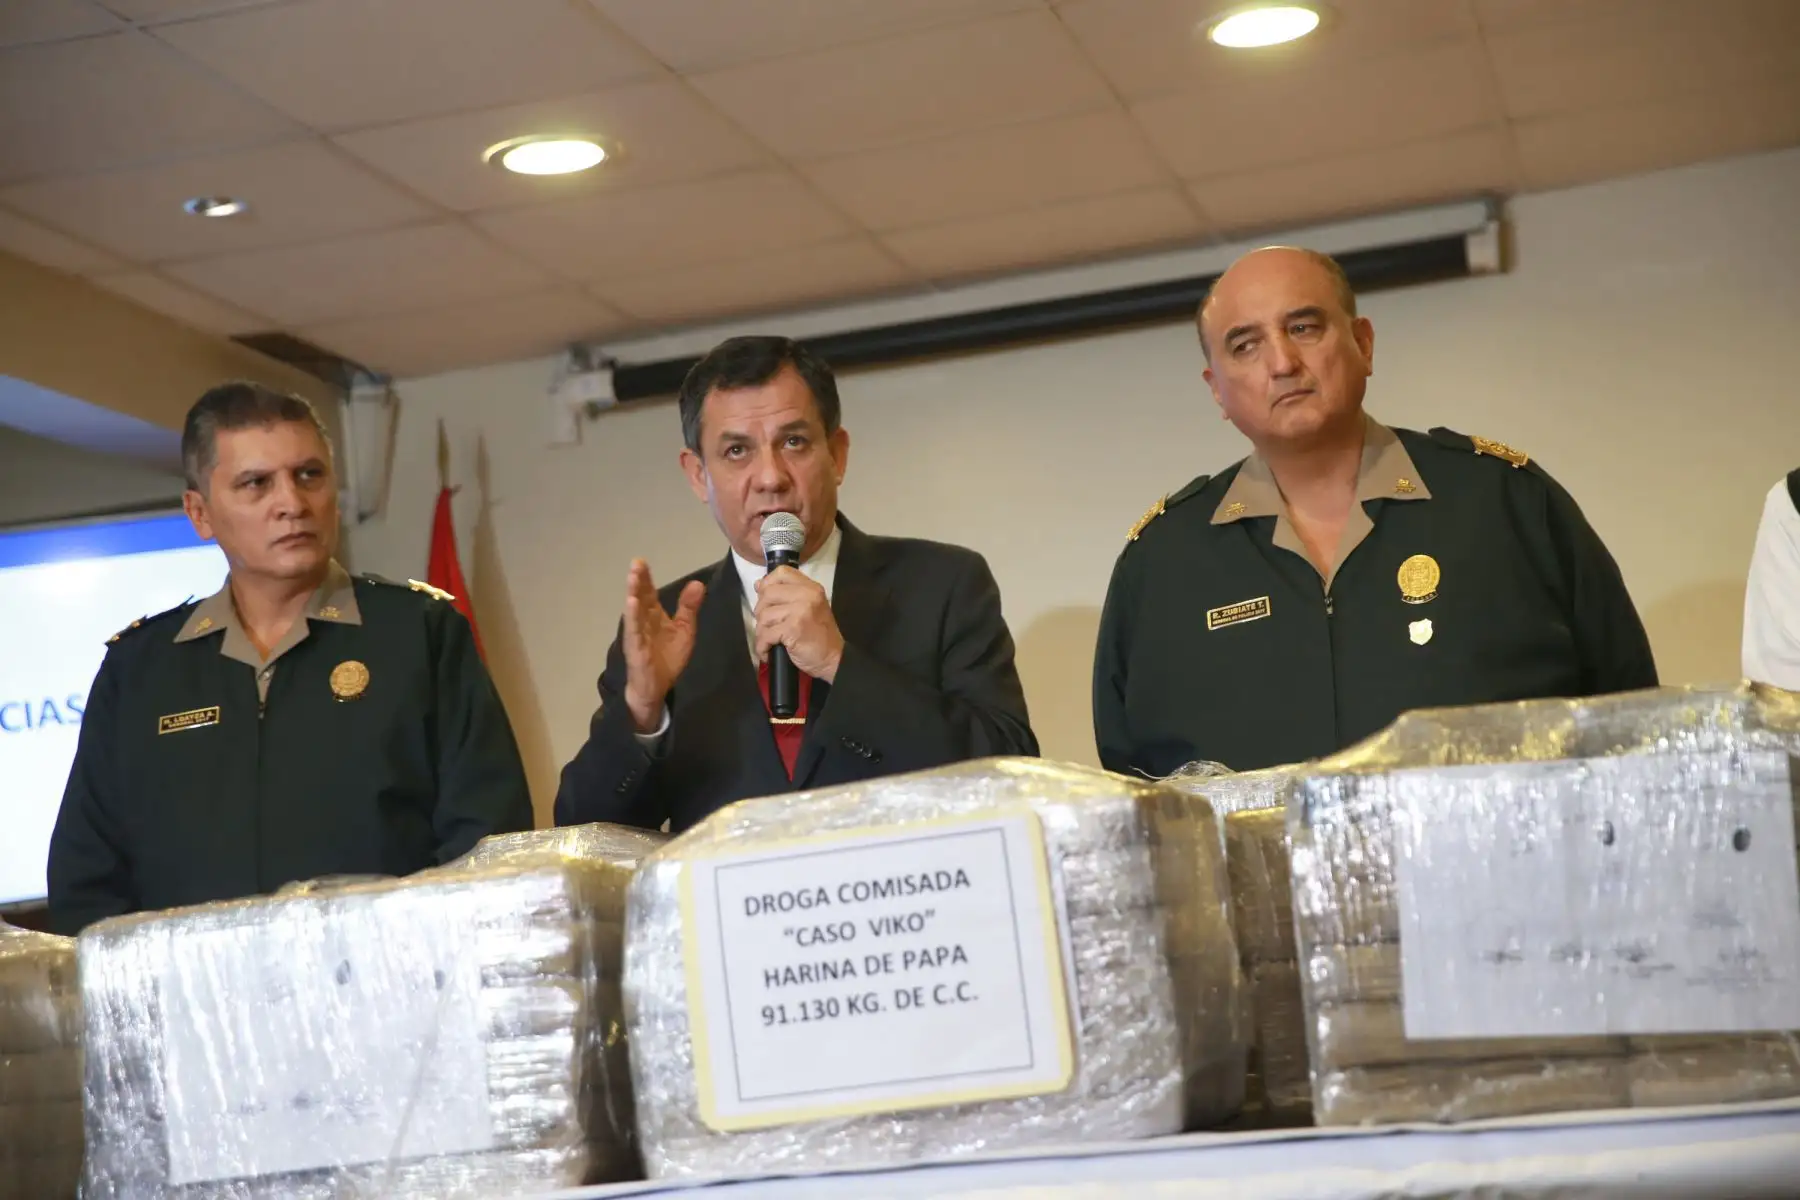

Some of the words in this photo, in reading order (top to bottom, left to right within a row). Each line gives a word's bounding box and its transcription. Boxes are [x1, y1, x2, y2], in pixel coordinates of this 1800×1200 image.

[1212, 611, 1221, 620] R.
[1222, 602, 1257, 618] ZUBIATE
[1257, 600, 1265, 609] T.
[744, 887, 831, 917] DROGA
[837, 868, 970, 904] COMISADA
[763, 958, 857, 989] HARINA
[864, 953, 895, 976] DE
[902, 944, 968, 971] PAPA
[761, 997, 840, 1027] 91.130
[847, 992, 887, 1016] KG.
[894, 986, 925, 1010] DE
[932, 980, 979, 1006] C.C.
